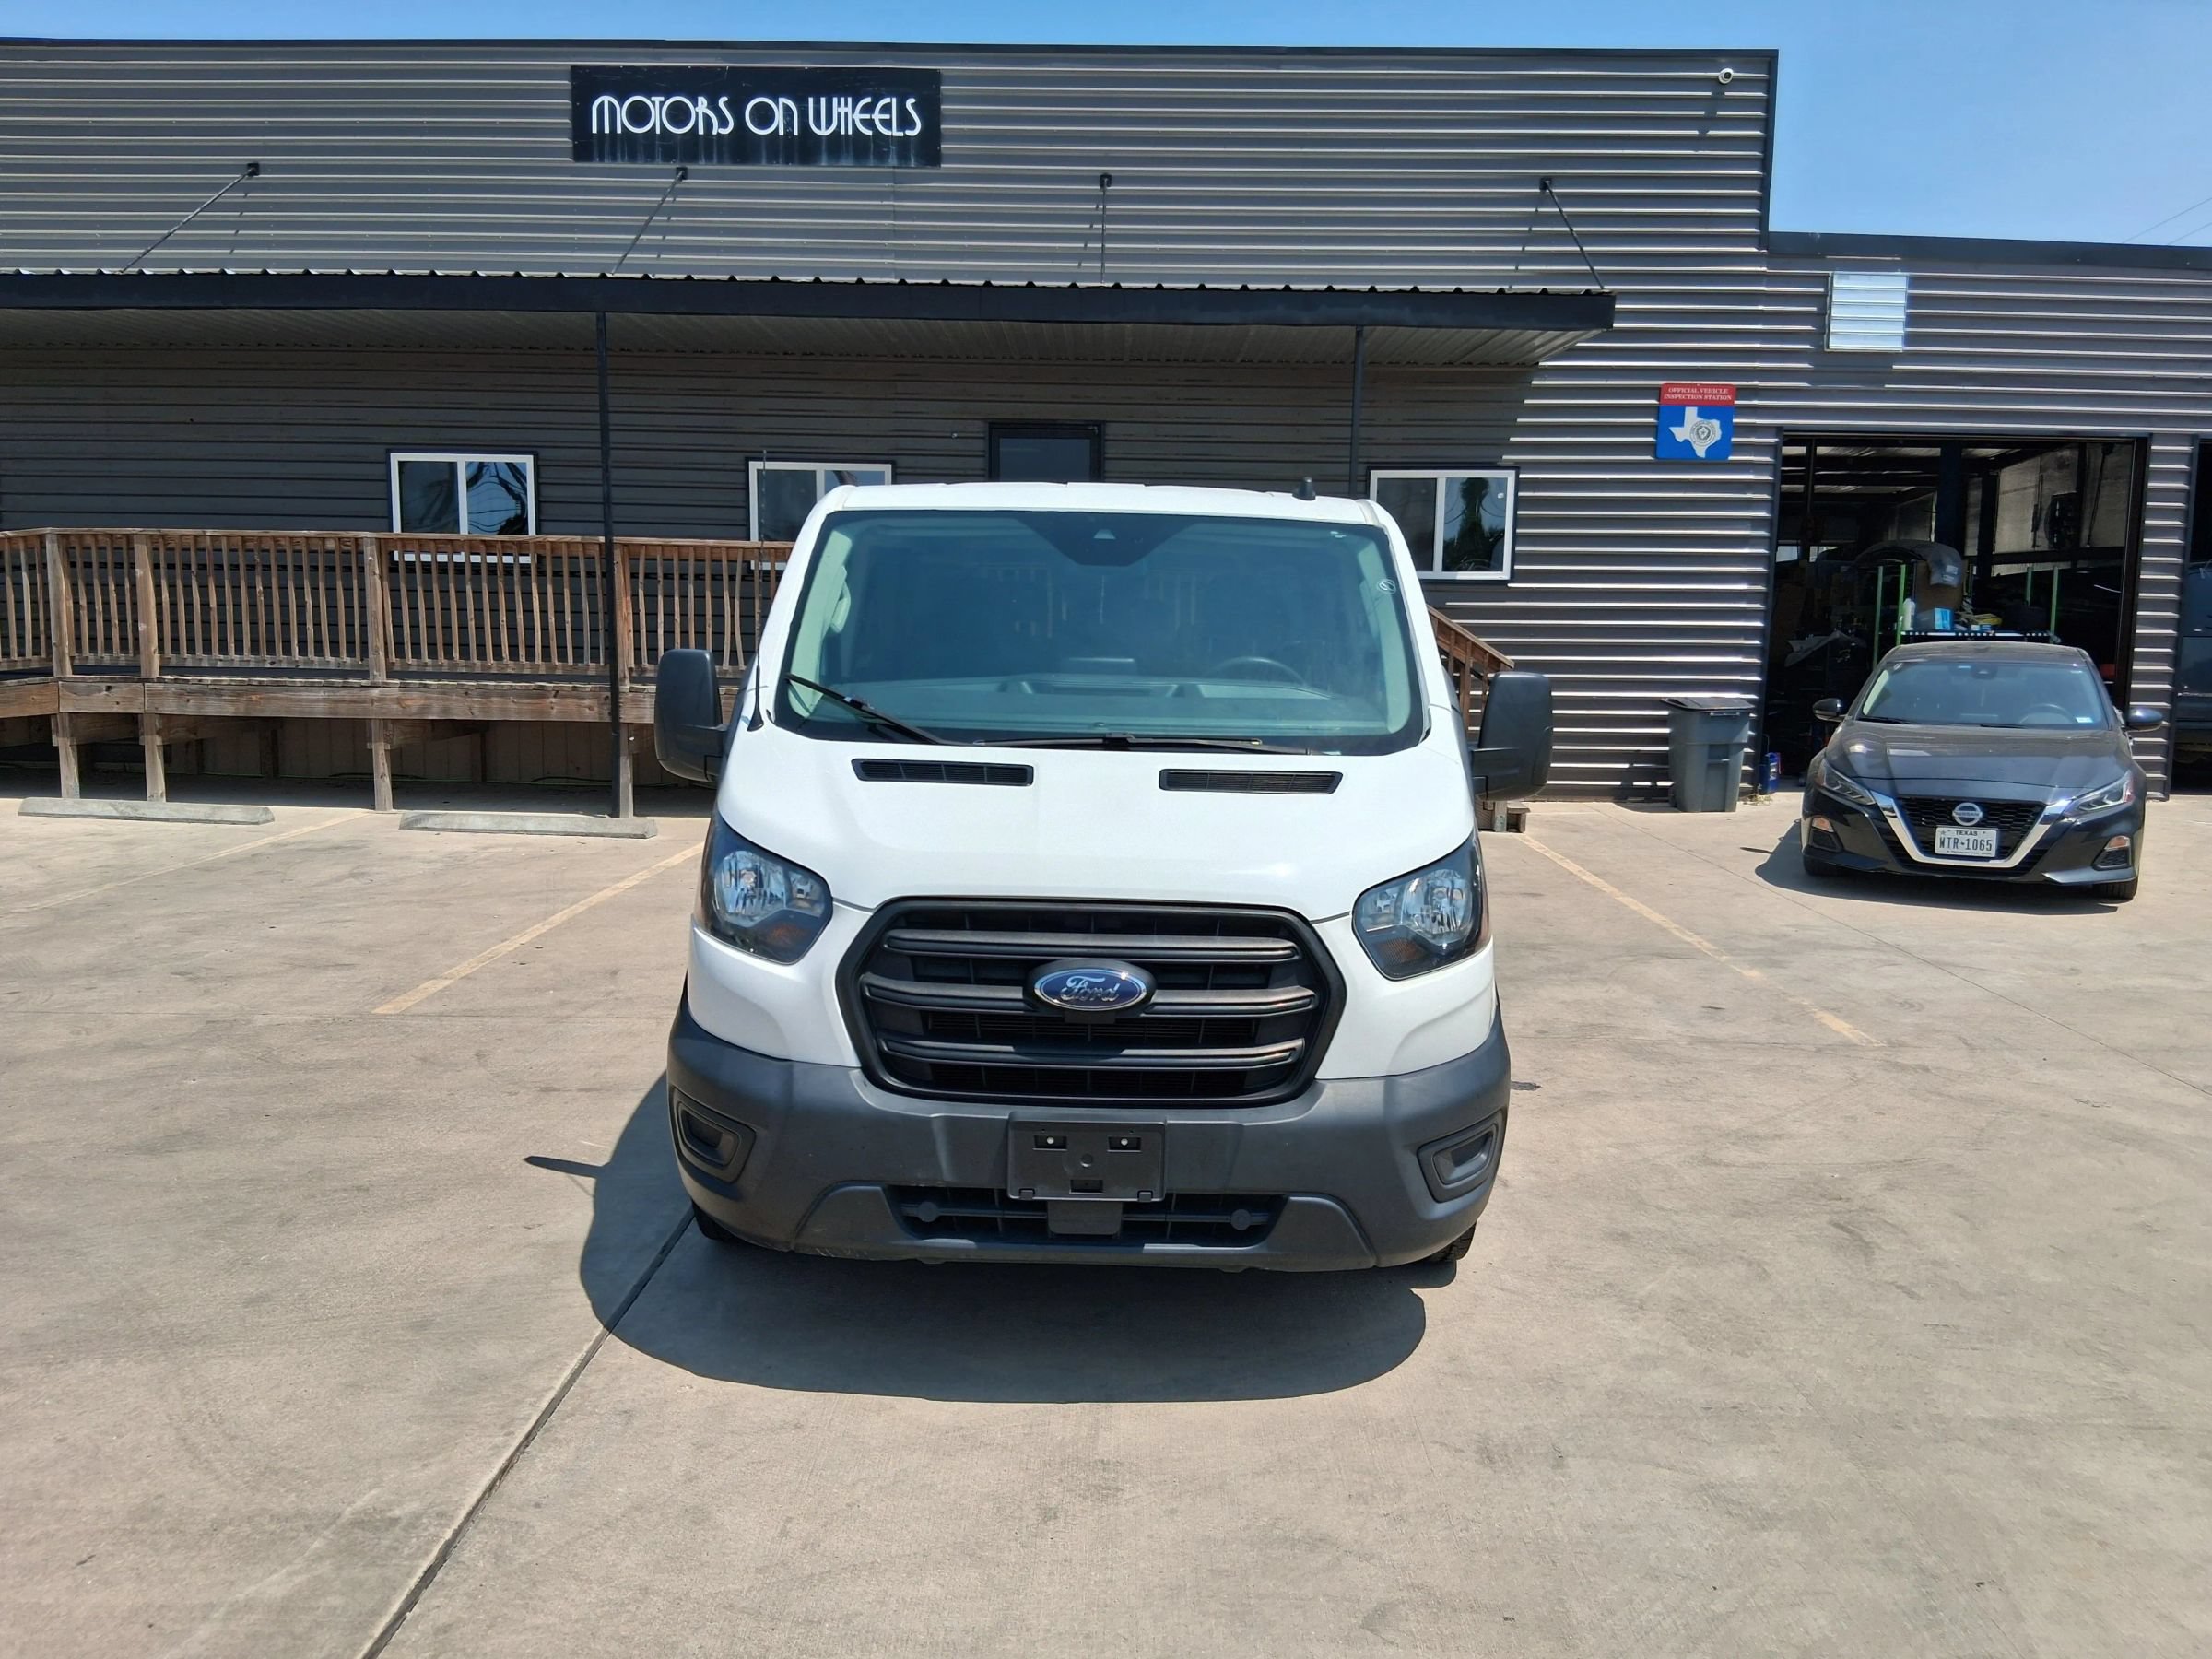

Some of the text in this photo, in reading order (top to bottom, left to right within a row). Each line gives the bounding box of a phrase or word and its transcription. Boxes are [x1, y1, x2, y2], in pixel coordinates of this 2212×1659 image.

[592, 95, 922, 136] MOTORS ON WHEELS
[1061, 975, 1121, 1002] Ford
